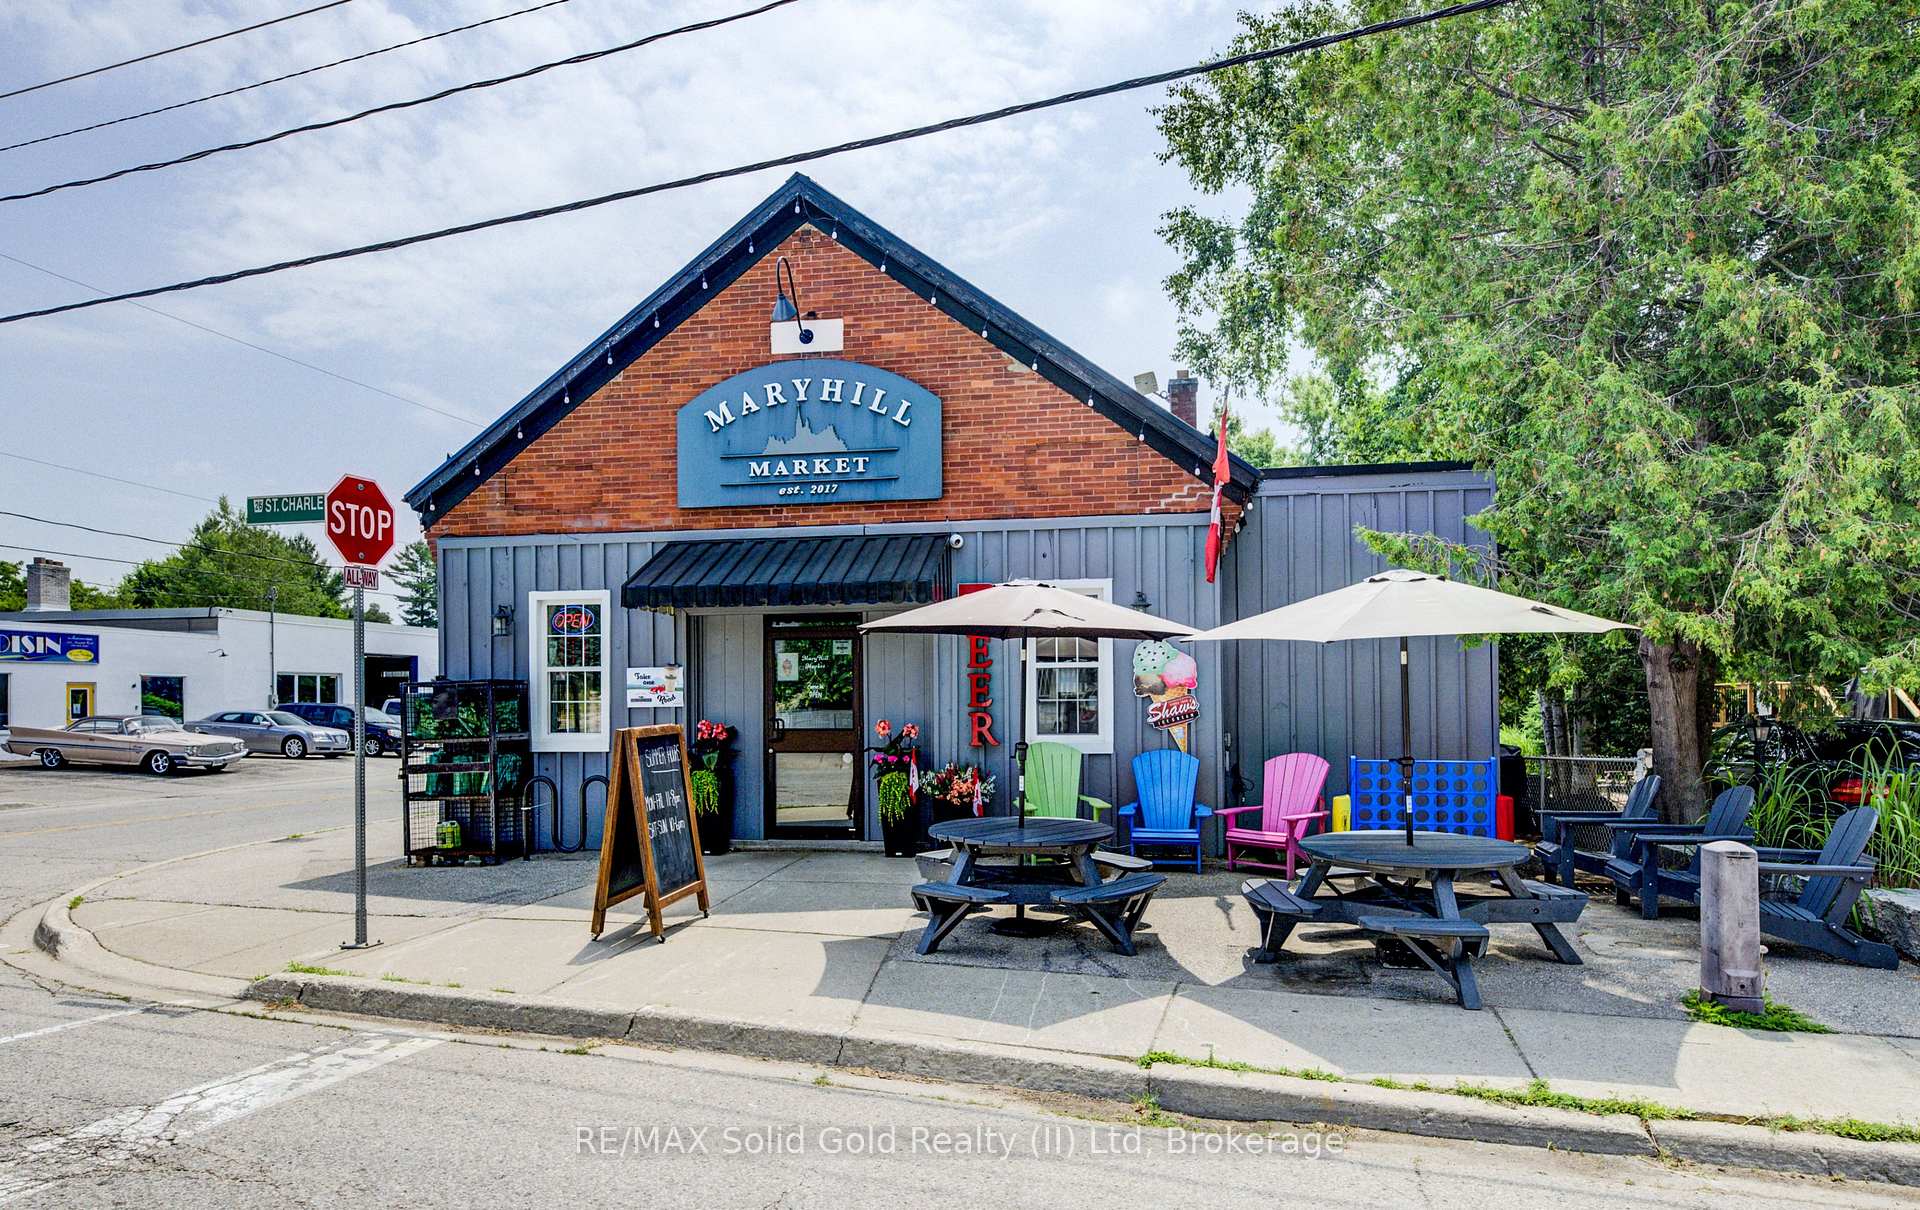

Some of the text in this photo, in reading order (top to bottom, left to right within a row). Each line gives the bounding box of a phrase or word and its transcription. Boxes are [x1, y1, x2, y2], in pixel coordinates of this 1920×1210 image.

[703, 378, 913, 433] MARYHILL
[749, 457, 869, 477] MARKET
[778, 484, 838, 495] est. 2017
[265, 499, 279, 512] ST.
[281, 496, 324, 512] CHARLE
[330, 500, 392, 541] STOP
[554, 613, 591, 628] OPEN
[967, 634, 1001, 748] EER
[1147, 699, 1198, 722] Shaw's
